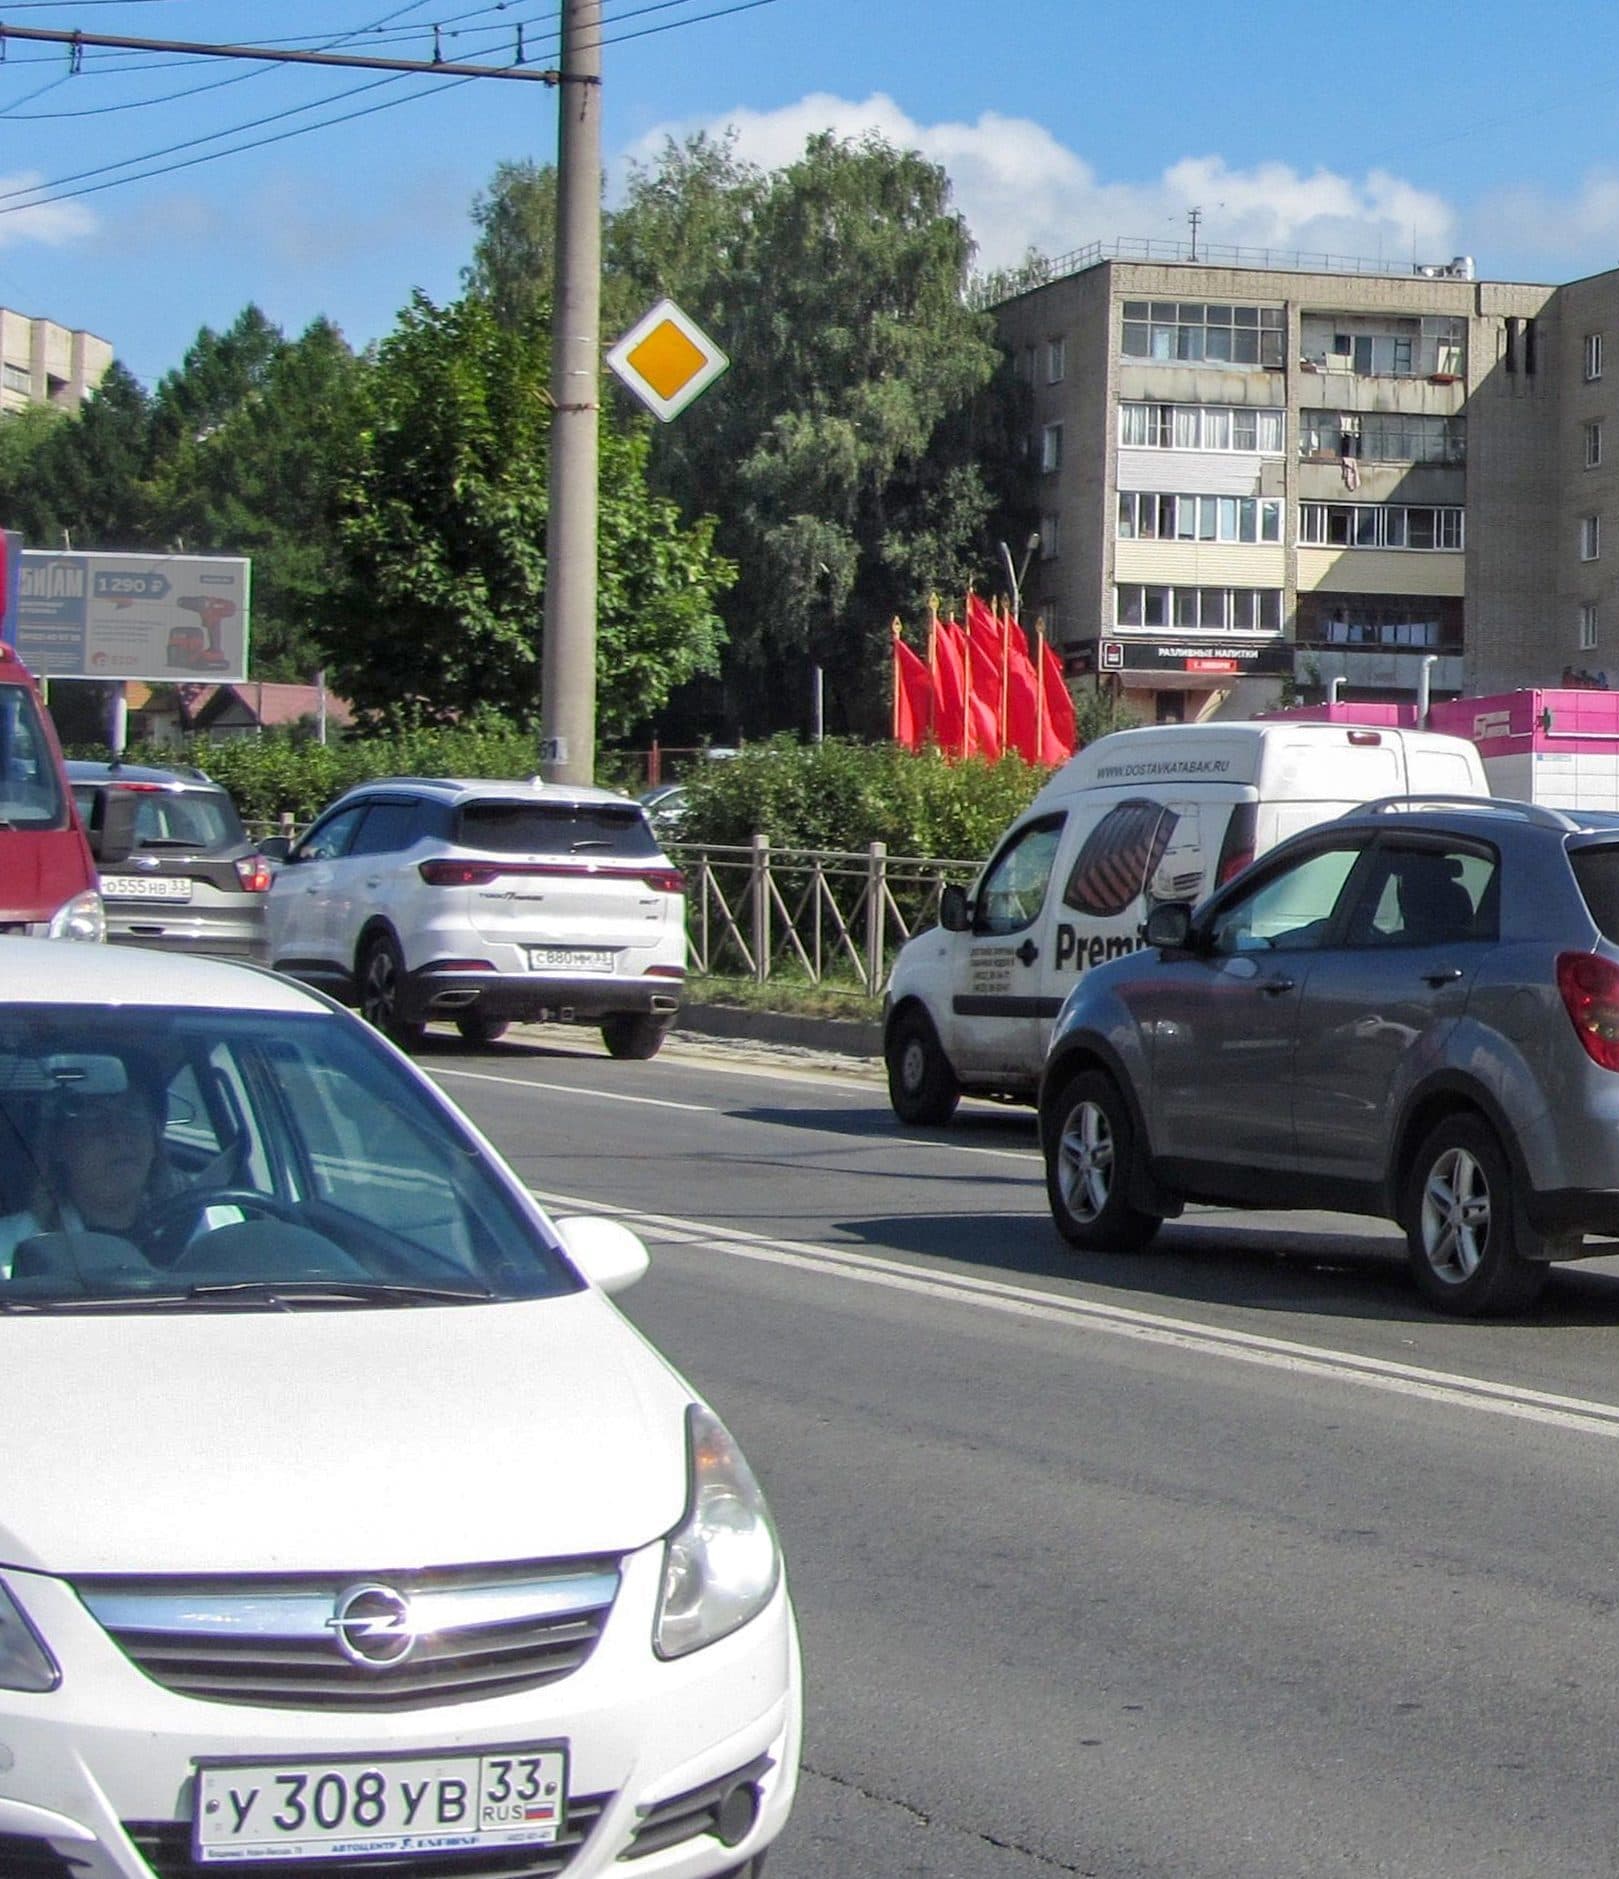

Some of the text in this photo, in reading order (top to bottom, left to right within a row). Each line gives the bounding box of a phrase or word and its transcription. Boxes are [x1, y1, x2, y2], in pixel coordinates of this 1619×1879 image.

[1215, 649, 1259, 659] НАПИТКИ
[1097, 760, 1230, 779] WWW.DOSTAVKATABAK.RU
[487, 1757, 544, 1801] 33
[482, 1804, 523, 1822] RUS
